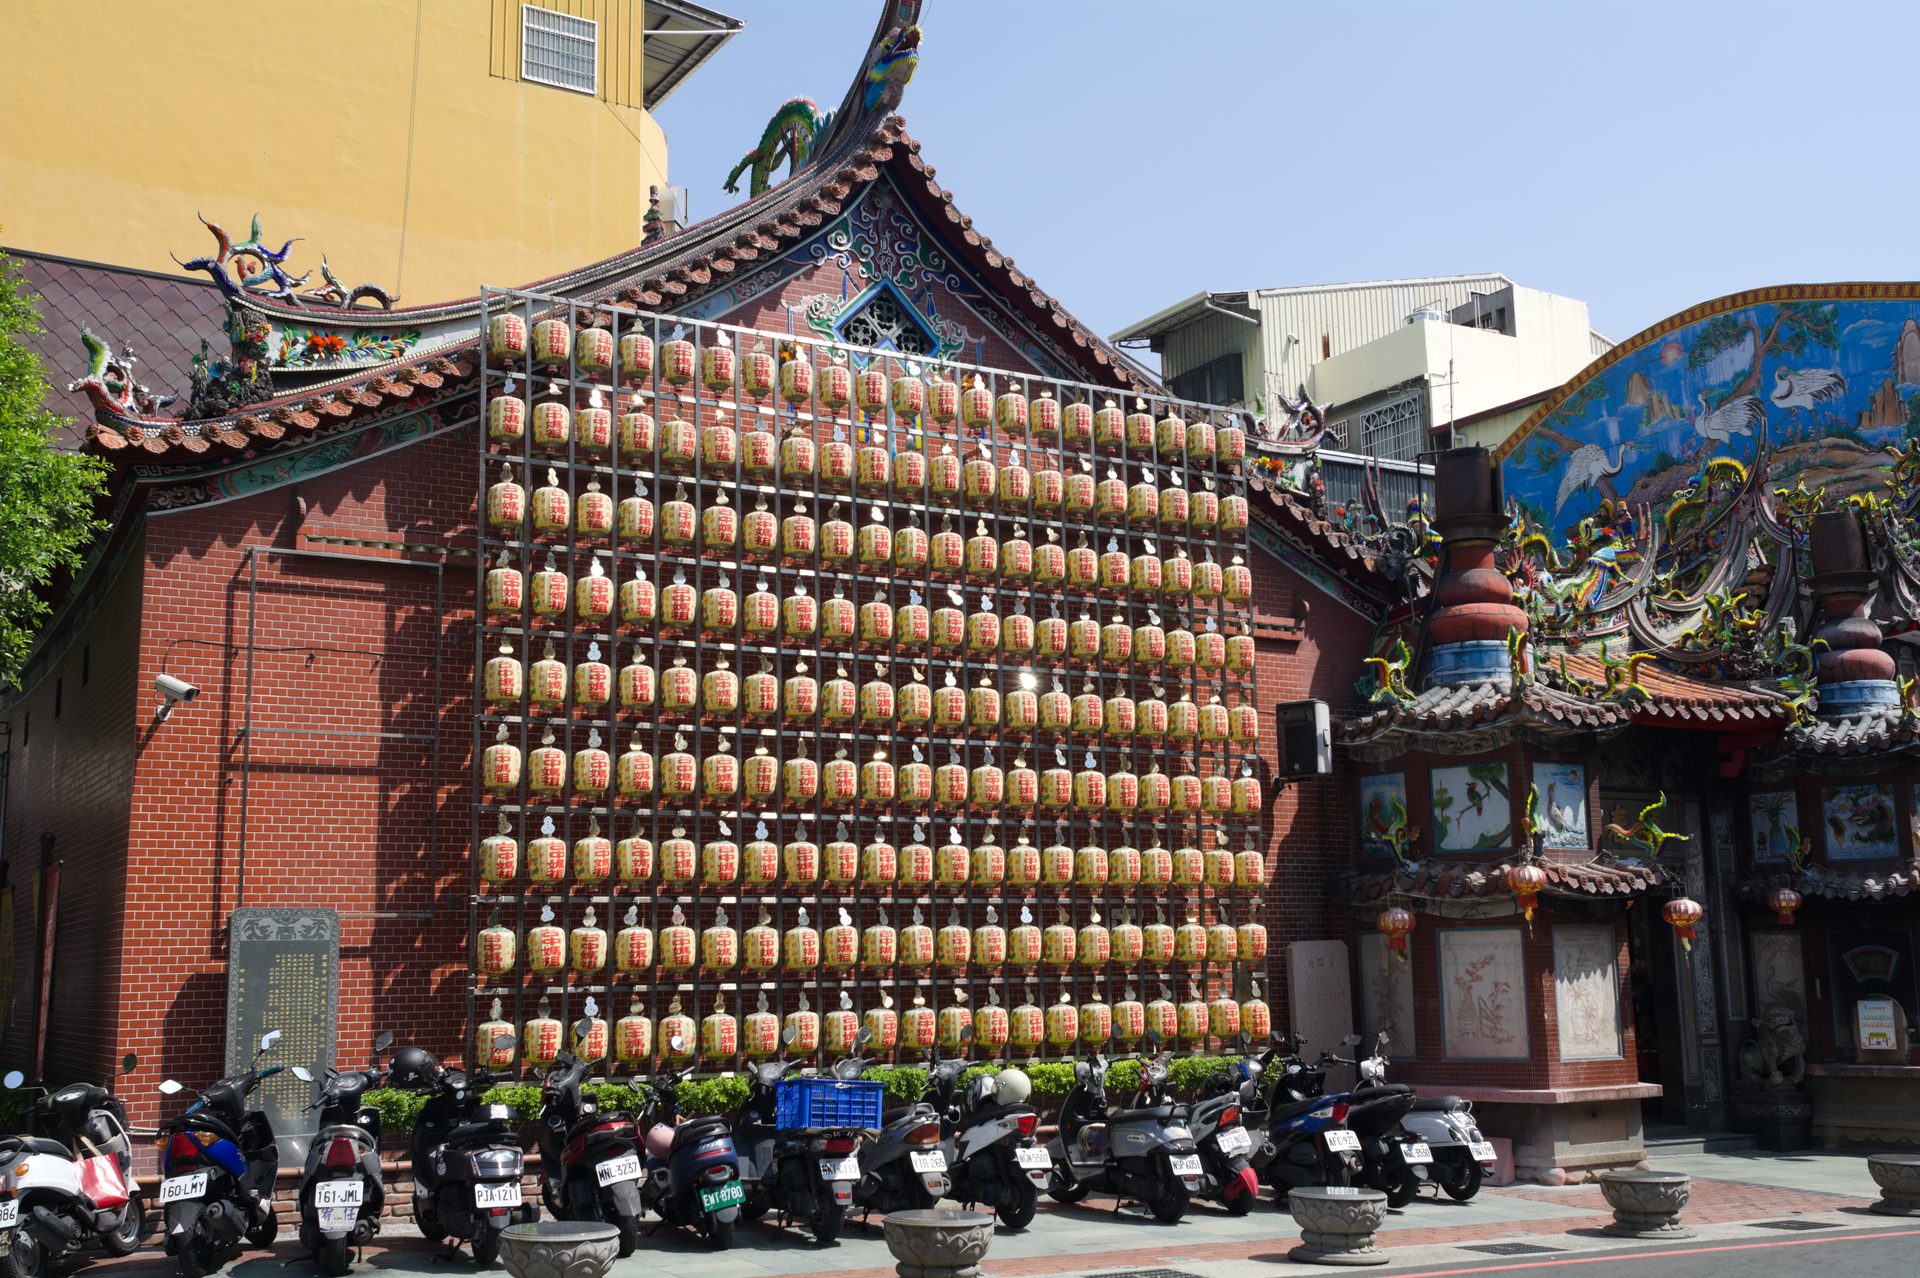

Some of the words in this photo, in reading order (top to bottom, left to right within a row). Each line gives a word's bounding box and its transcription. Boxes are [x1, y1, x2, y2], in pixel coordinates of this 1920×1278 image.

[506, 317, 522, 351] 台中媽祖
[549, 322, 566, 355] 台中媽祖
[595, 332, 611, 365] 台中媽祖
[634, 337, 651, 369] 台中媽祖
[675, 343, 691, 374] 台中媽祖
[715, 350, 731, 382] 台中媽祖
[755, 354, 770, 388] 台中媽祖
[795, 363, 810, 393] 台中媽祖
[866, 373, 882, 403] 台中媽祖
[939, 383, 954, 414] 台中媽祖
[504, 400, 519, 432] 台中媽祖
[547, 404, 563, 436] 台中媽祖
[974, 389, 989, 420] 台中媽祖
[1040, 400, 1055, 430] 台中媽祖
[1075, 404, 1090, 434] 台中媽祖
[593, 412, 607, 444] 台中媽祖
[633, 416, 650, 447] 台中媽祖
[716, 427, 731, 459] 台中媽祖
[1137, 414, 1152, 443] 台中媽祖
[753, 434, 768, 465] 台中媽祖
[797, 440, 811, 471] 台中媽祖
[831, 444, 846, 475] 台中媽祖
[872, 448, 886, 481] 台中媽祖
[907, 455, 922, 485] 台中媽祖
[944, 457, 958, 489] 台中媽祖
[978, 462, 991, 493] 台中媽祖
[1010, 466, 1024, 497] 台中媽祖
[502, 486, 518, 520] 台中媽祖
[550, 491, 566, 524] 台中媽祖
[1078, 477, 1092, 506] 台中媽祖
[1110, 480, 1125, 510] 台中媽祖
[587, 495, 603, 528] 台中媽祖
[639, 500, 652, 534] 台中媽祖
[679, 503, 693, 537] 台中媽祖
[719, 509, 734, 541] 台中媽祖
[755, 514, 771, 546] 台中媽祖
[795, 518, 810, 550] 台中媽祖
[833, 525, 849, 556] 台中媽祖
[875, 527, 889, 560] 台中媽祖
[945, 535, 961, 565] 台中媽祖
[981, 539, 995, 570] 台中媽祖
[1017, 543, 1030, 573] 台中媽祖
[1111, 555, 1125, 583] 台中媽祖
[503, 572, 520, 607] 台中媽祖
[550, 575, 566, 610] 台中媽祖
[592, 580, 609, 612] 台中媽祖
[638, 583, 652, 617] 台中媽祖
[671, 587, 690, 621] 台中媽祖
[717, 591, 734, 625] 台中媽祖
[759, 595, 774, 627] 台中媽祖
[797, 597, 813, 630] 台中媽祖
[839, 602, 853, 634] 台中媽祖
[874, 605, 889, 636] 台中媽祖
[914, 608, 927, 640] 台中媽祖
[948, 611, 961, 643] 台中媽祖
[981, 615, 997, 647] 台中媽祖
[1014, 618, 1029, 649] 台中媽祖
[1051, 621, 1065, 650] 台中媽祖
[1117, 627, 1131, 656] 台中媽祖
[499, 661, 514, 696] 台中媽祖
[547, 664, 563, 699] 台中媽祖
[589, 666, 606, 700] 台中媽祖
[632, 669, 650, 702] 台中媽祖
[675, 671, 690, 704] 台中媽祖
[716, 674, 732, 706] 台中媽祖
[759, 678, 775, 710] 台中媽祖
[797, 680, 813, 712] 台中媽祖
[842, 683, 855, 714] 台中媽祖
[876, 685, 891, 716] 台中媽祖
[948, 690, 963, 721] 台中媽祖
[984, 690, 997, 720] 台中媽祖
[1022, 692, 1035, 723] 台中媽祖
[1055, 693, 1069, 723] 台中媽祖
[1118, 700, 1132, 729] 台中媽祖
[1241, 708, 1255, 736] 台中媽祖
[495, 749, 511, 782] 台中媽祖
[543, 752, 561, 786] 台中媽祖
[590, 754, 607, 787] 台中媽祖
[634, 755, 650, 789] 台中媽祖
[674, 757, 693, 790] 台中媽祖
[718, 758, 733, 792] 台中媽祖
[757, 761, 772, 793] 台中媽祖
[800, 762, 815, 795] 台中媽祖
[836, 764, 854, 796] 台中媽祖
[877, 765, 892, 797] 台中媽祖
[919, 767, 931, 799] 台中媽祖
[949, 769, 965, 799] 台中媽祖
[986, 768, 1000, 800] 台中媽祖
[1019, 770, 1034, 800] 台中媽祖
[1057, 773, 1071, 802] 台中媽祖
[1089, 773, 1103, 803] 台中媽祖
[1122, 776, 1136, 806] 台中媽祖
[1185, 778, 1199, 807] 台中媽祖
[1218, 777, 1231, 807] 台中媽祖
[1246, 780, 1260, 809] 台中媽祖
[498, 843, 515, 878] 台中媽祖
[548, 843, 565, 878] 台中媽祖
[594, 843, 610, 876] 台中媽祖
[632, 843, 650, 876] 台中媽祖
[674, 845, 691, 877] 台中媽祖
[719, 846, 735, 879] 台中媽祖
[761, 847, 776, 879] 台中媽祖
[798, 846, 814, 879] 台中媽祖
[839, 846, 854, 878] 台中媽祖
[880, 847, 894, 880] 台中媽祖
[914, 848, 930, 881] 台中媽祖
[952, 848, 965, 878] 台中媽祖
[991, 848, 1003, 880] 台中媽祖
[1218, 853, 1231, 883] 台中媽祖
[484, 935, 503, 971] 台中媽祖
[542, 930, 561, 966] 台中媽祖
[580, 933, 598, 969] 台中媽祖
[629, 932, 647, 967] 台中媽祖
[673, 930, 691, 965] 台中媽祖
[716, 933, 731, 966] 台中媽祖
[759, 931, 775, 965] 台中媽祖
[803, 931, 816, 964] 台中媽祖
[837, 929, 853, 961] 台中媽祖
[880, 930, 893, 962] 台中媽祖
[954, 928, 967, 961] 台中媽祖
[989, 929, 1001, 961] 台中媽祖
[1027, 928, 1039, 960] 台中媽祖
[1252, 927, 1265, 957] 台中媽祖
[760, 1019, 775, 1050] 台中媽祖
[799, 1016, 816, 1049] 台中媽祖
[843, 1014, 857, 1046] 台中媽祖
[883, 1013, 896, 1046] 台中媽祖
[918, 1012, 934, 1045] 台中媽祖
[991, 1010, 1007, 1042] 台中媽祖
[1030, 1009, 1042, 1041] 台中媽祖
[1253, 1004, 1268, 1033] 台中媽祖
[540, 1024, 557, 1058] 台中媽祖
[589, 1024, 603, 1059] 台中媽祖
[625, 1023, 646, 1057] 台中媽祖
[721, 1019, 736, 1052] 台中媽祖
